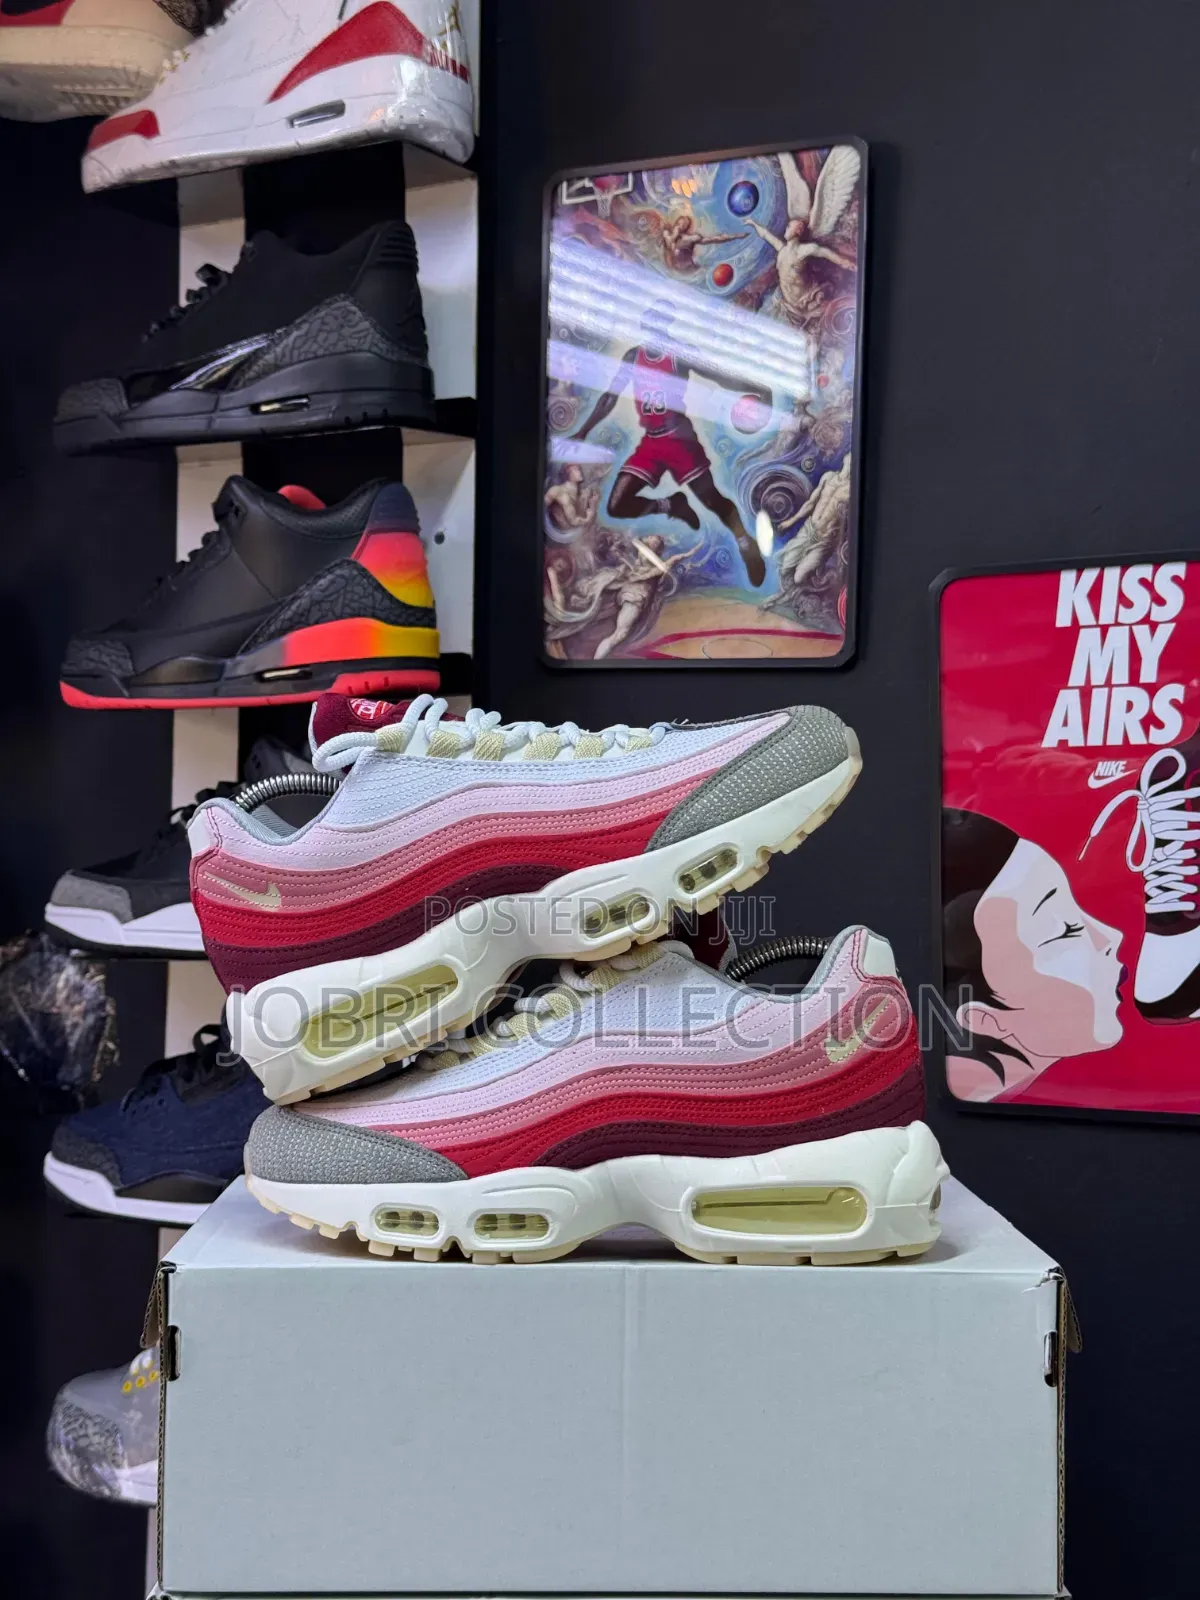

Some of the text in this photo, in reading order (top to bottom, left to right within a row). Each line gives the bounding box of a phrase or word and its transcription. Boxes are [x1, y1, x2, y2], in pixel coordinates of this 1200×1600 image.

[1055, 561, 1187, 628] KISS
[1067, 622, 1177, 687] MY
[1041, 683, 1185, 748] AIRS
[1094, 760, 1128, 777] NIKE
